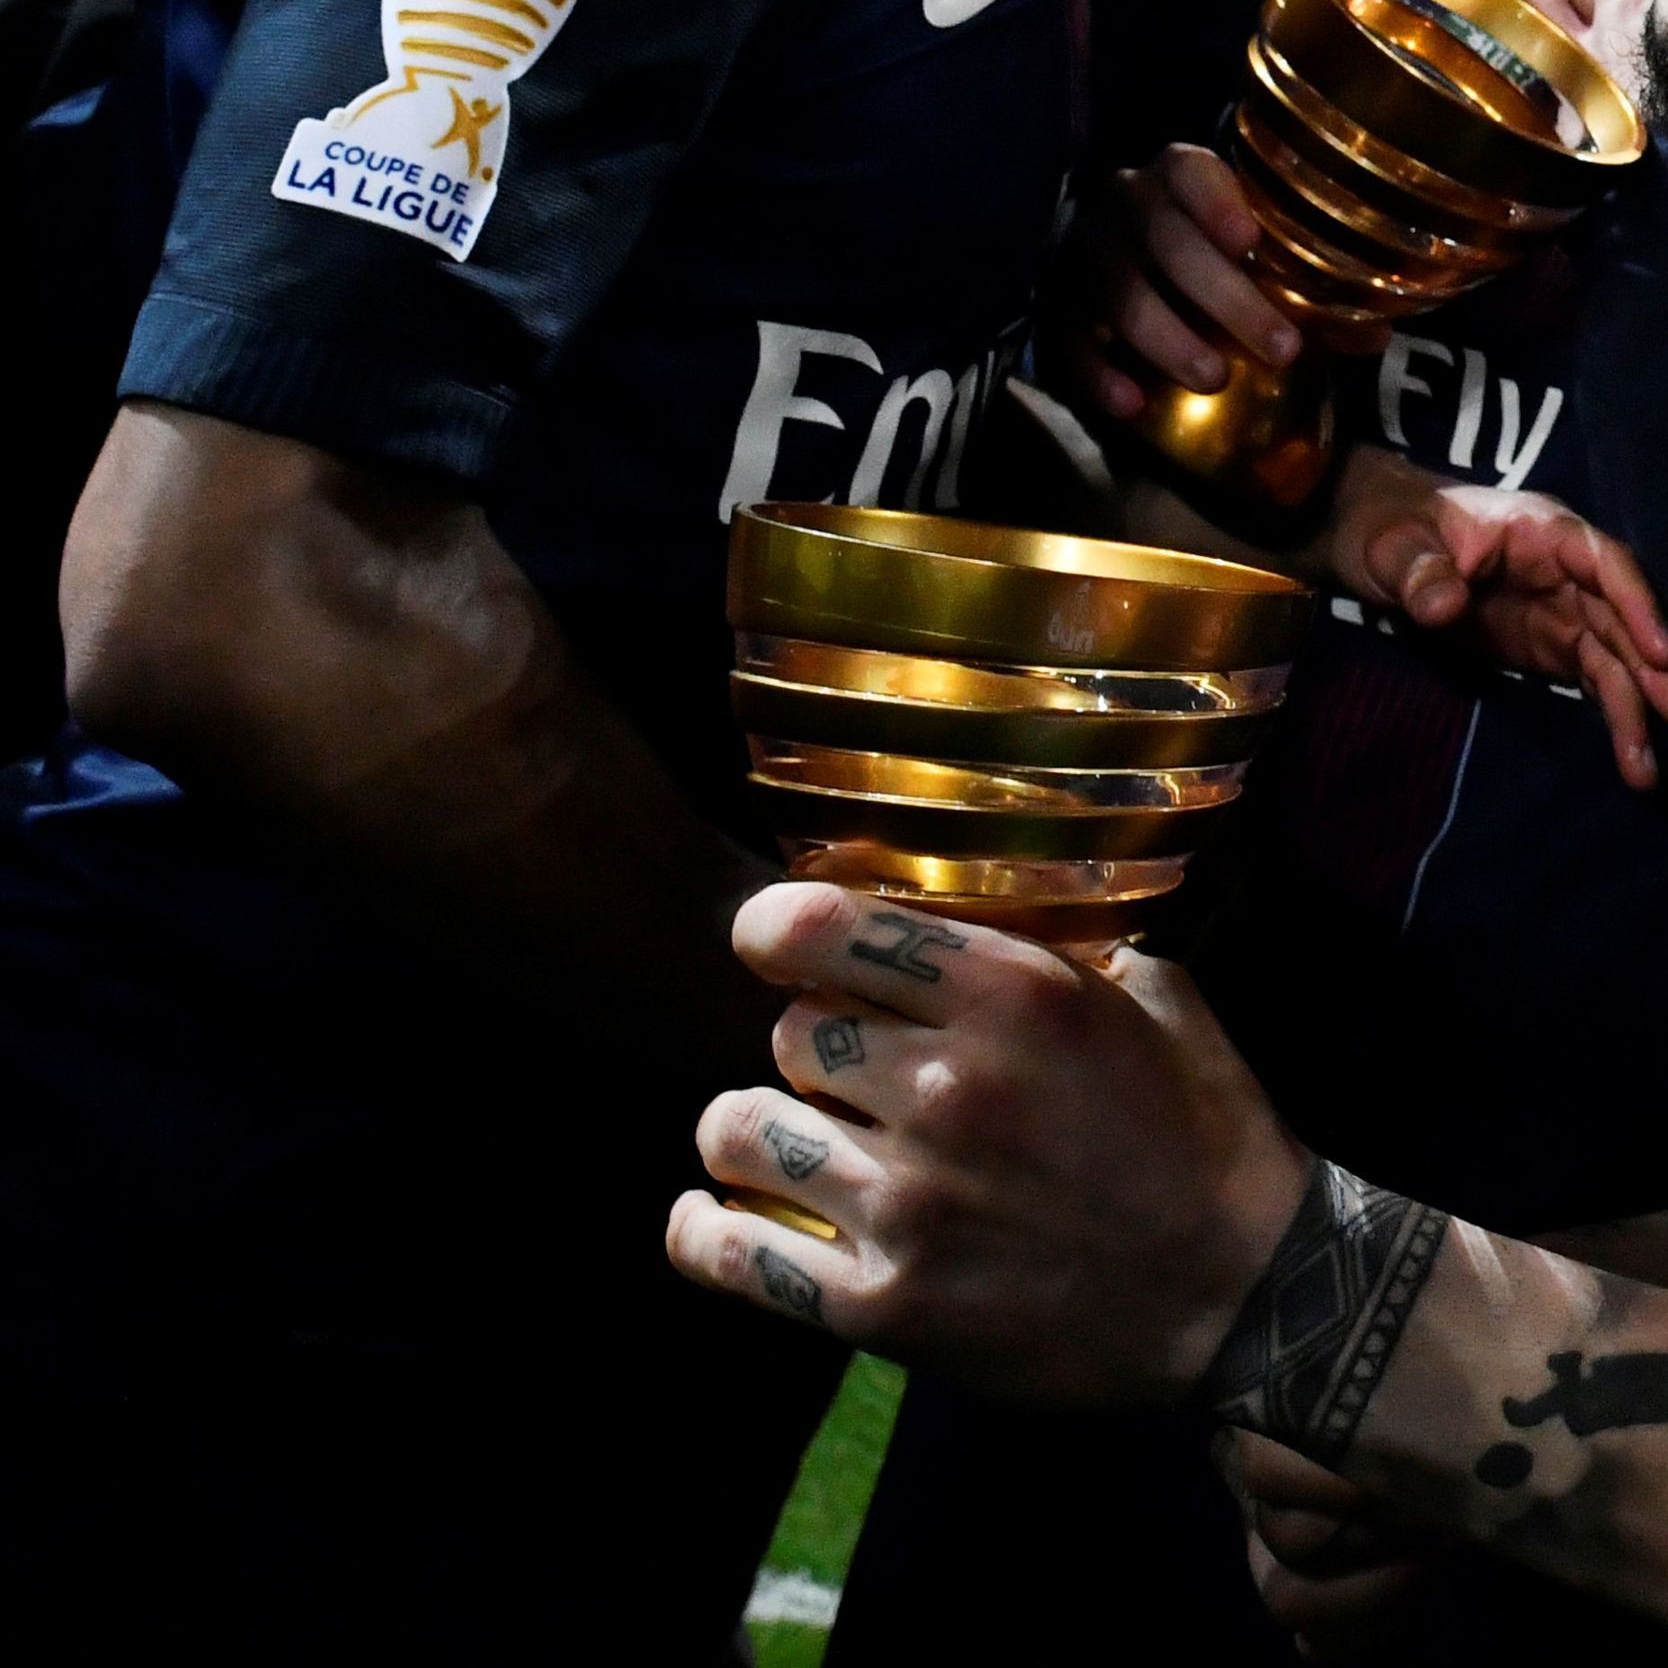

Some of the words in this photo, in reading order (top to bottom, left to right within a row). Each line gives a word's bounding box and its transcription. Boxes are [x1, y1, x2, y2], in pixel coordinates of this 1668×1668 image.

[287, 160, 337, 198] LA
[351, 176, 473, 247] LIGUE
[325, 141, 424, 184] COUPE
[430, 173, 470, 205] DE
[1377, 331, 1565, 492] Fly
